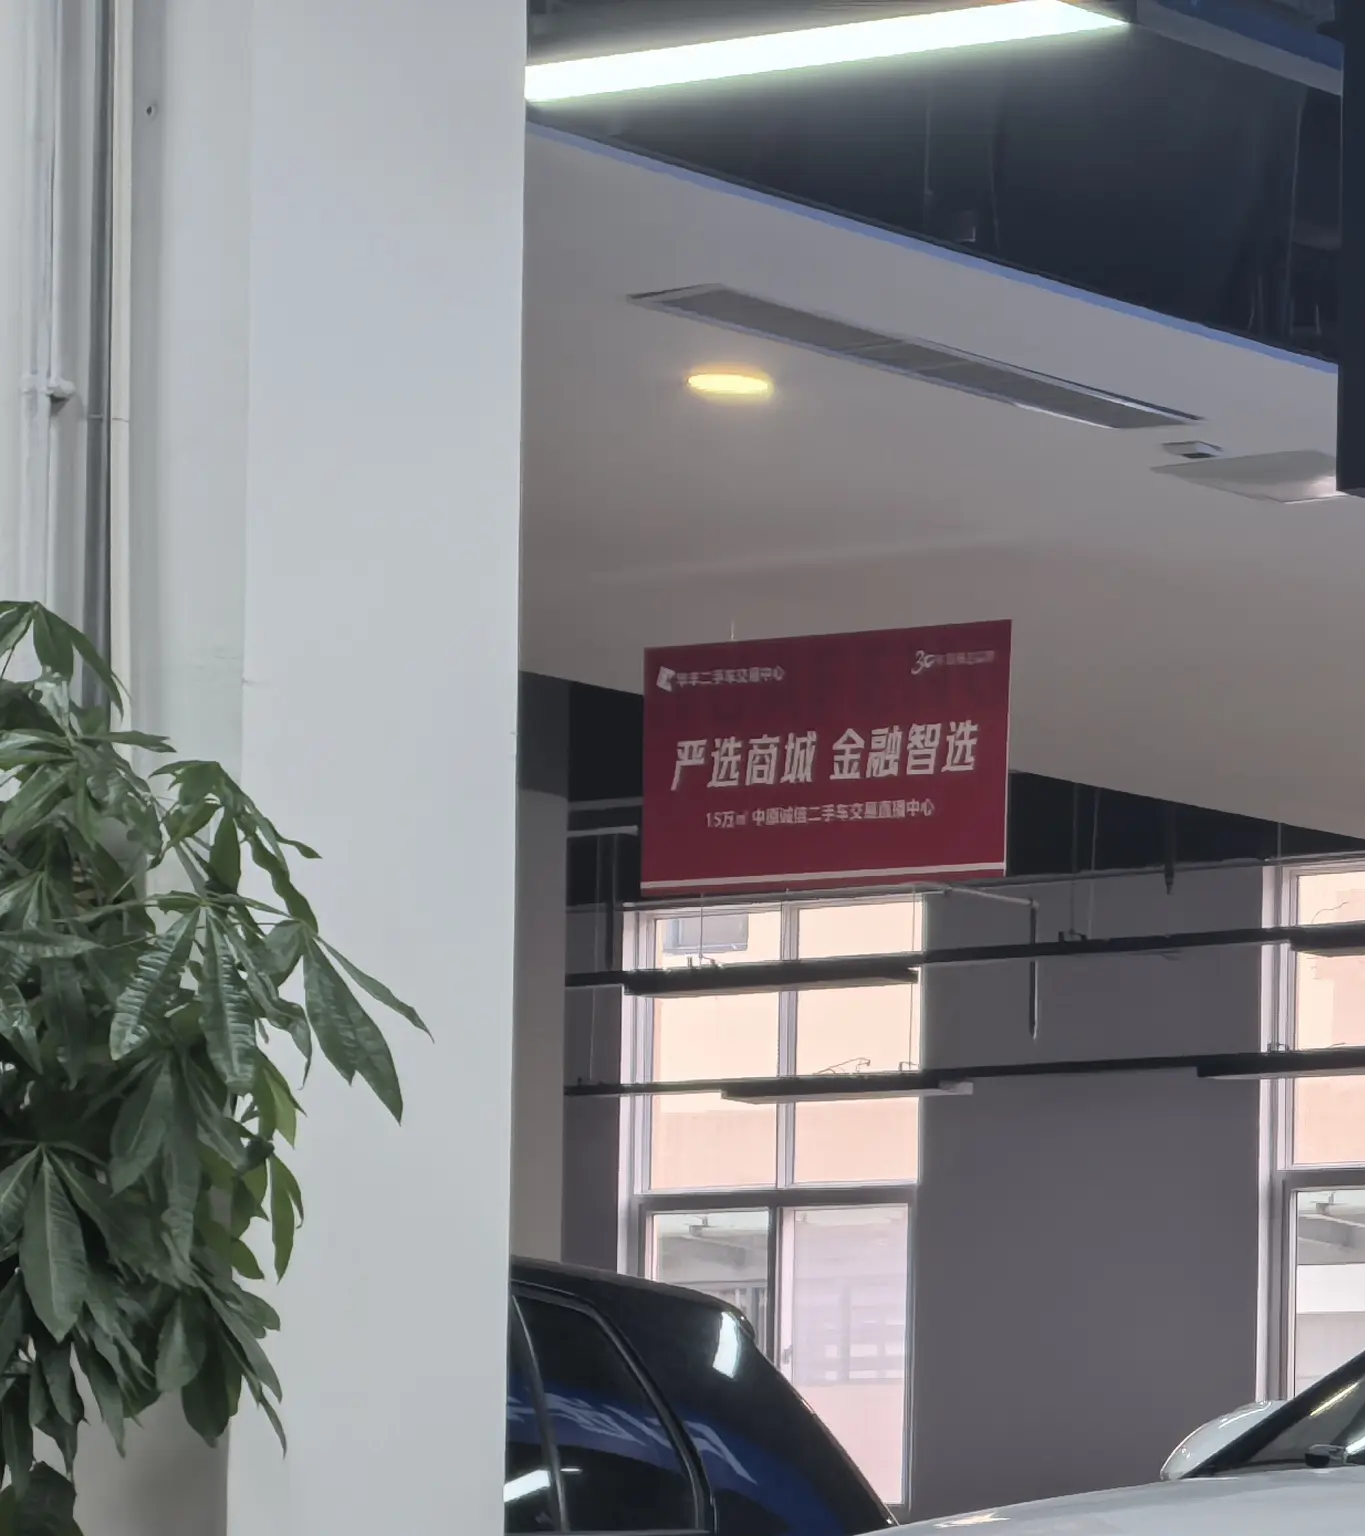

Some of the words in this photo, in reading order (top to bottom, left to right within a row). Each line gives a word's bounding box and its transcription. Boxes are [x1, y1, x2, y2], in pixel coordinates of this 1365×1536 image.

[670, 731, 817, 791] 严选商城
[829, 720, 978, 780] 金融智选
